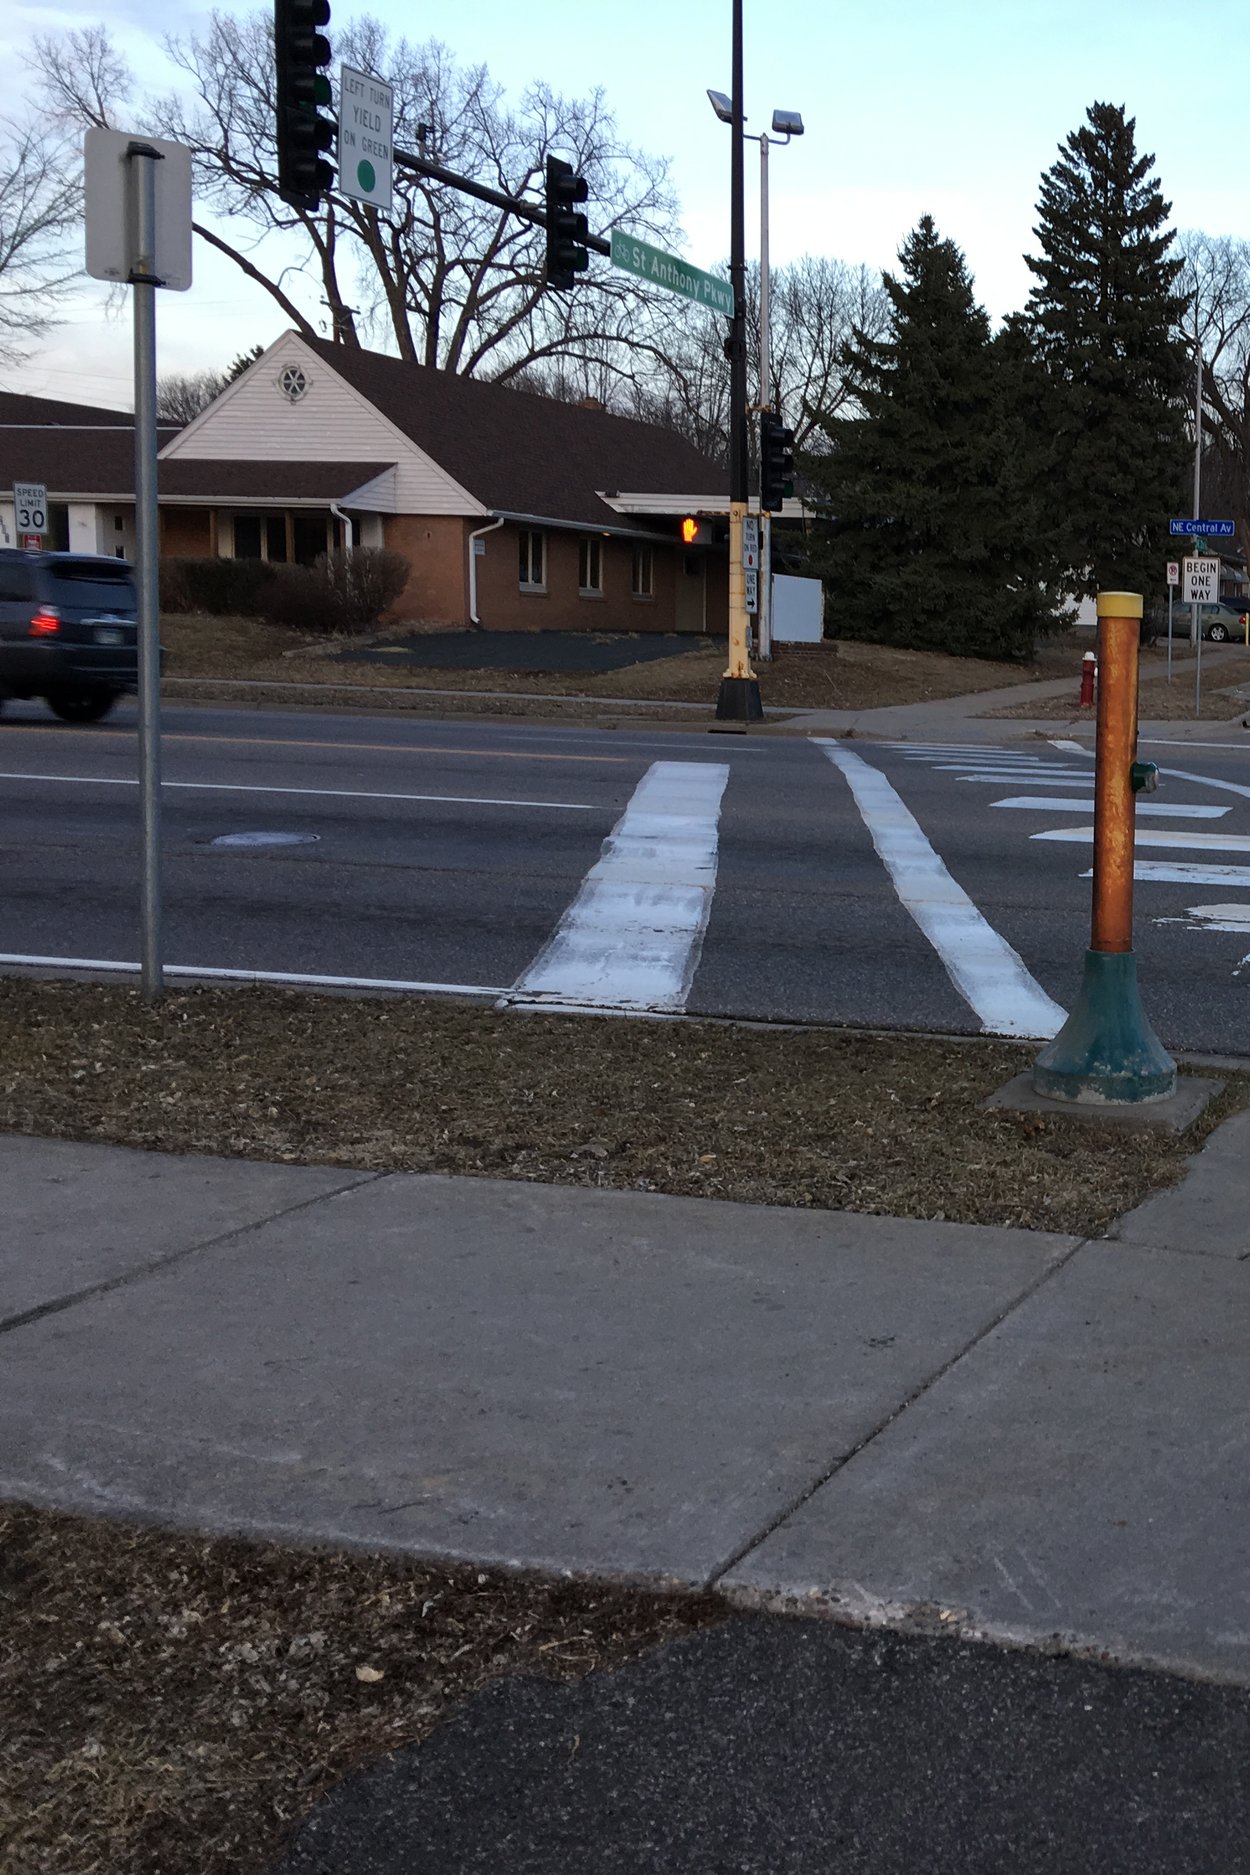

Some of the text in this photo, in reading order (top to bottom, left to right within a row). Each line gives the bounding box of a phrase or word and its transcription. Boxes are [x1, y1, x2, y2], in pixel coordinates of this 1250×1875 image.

[344, 76, 390, 109] LEFT TURN
[353, 105, 381, 132] YIELD
[344, 129, 389, 159] ON GREEN
[632, 246, 731, 312] St Anthony Pkwy
[17, 488, 44, 498] SPEED
[20, 499, 41, 508] LIMIT
[19, 509, 44, 528] 30
[746, 520, 754, 531] NO
[1172, 522, 1232, 533] NE Central Av
[745, 532, 755, 541] TURN
[1186, 562, 1217, 574] BEGIN
[746, 574, 755, 585] ONE
[1191, 575, 1211, 587] ONE
[747, 586, 755, 595] WAY
[1190, 589, 1211, 600] WAY
